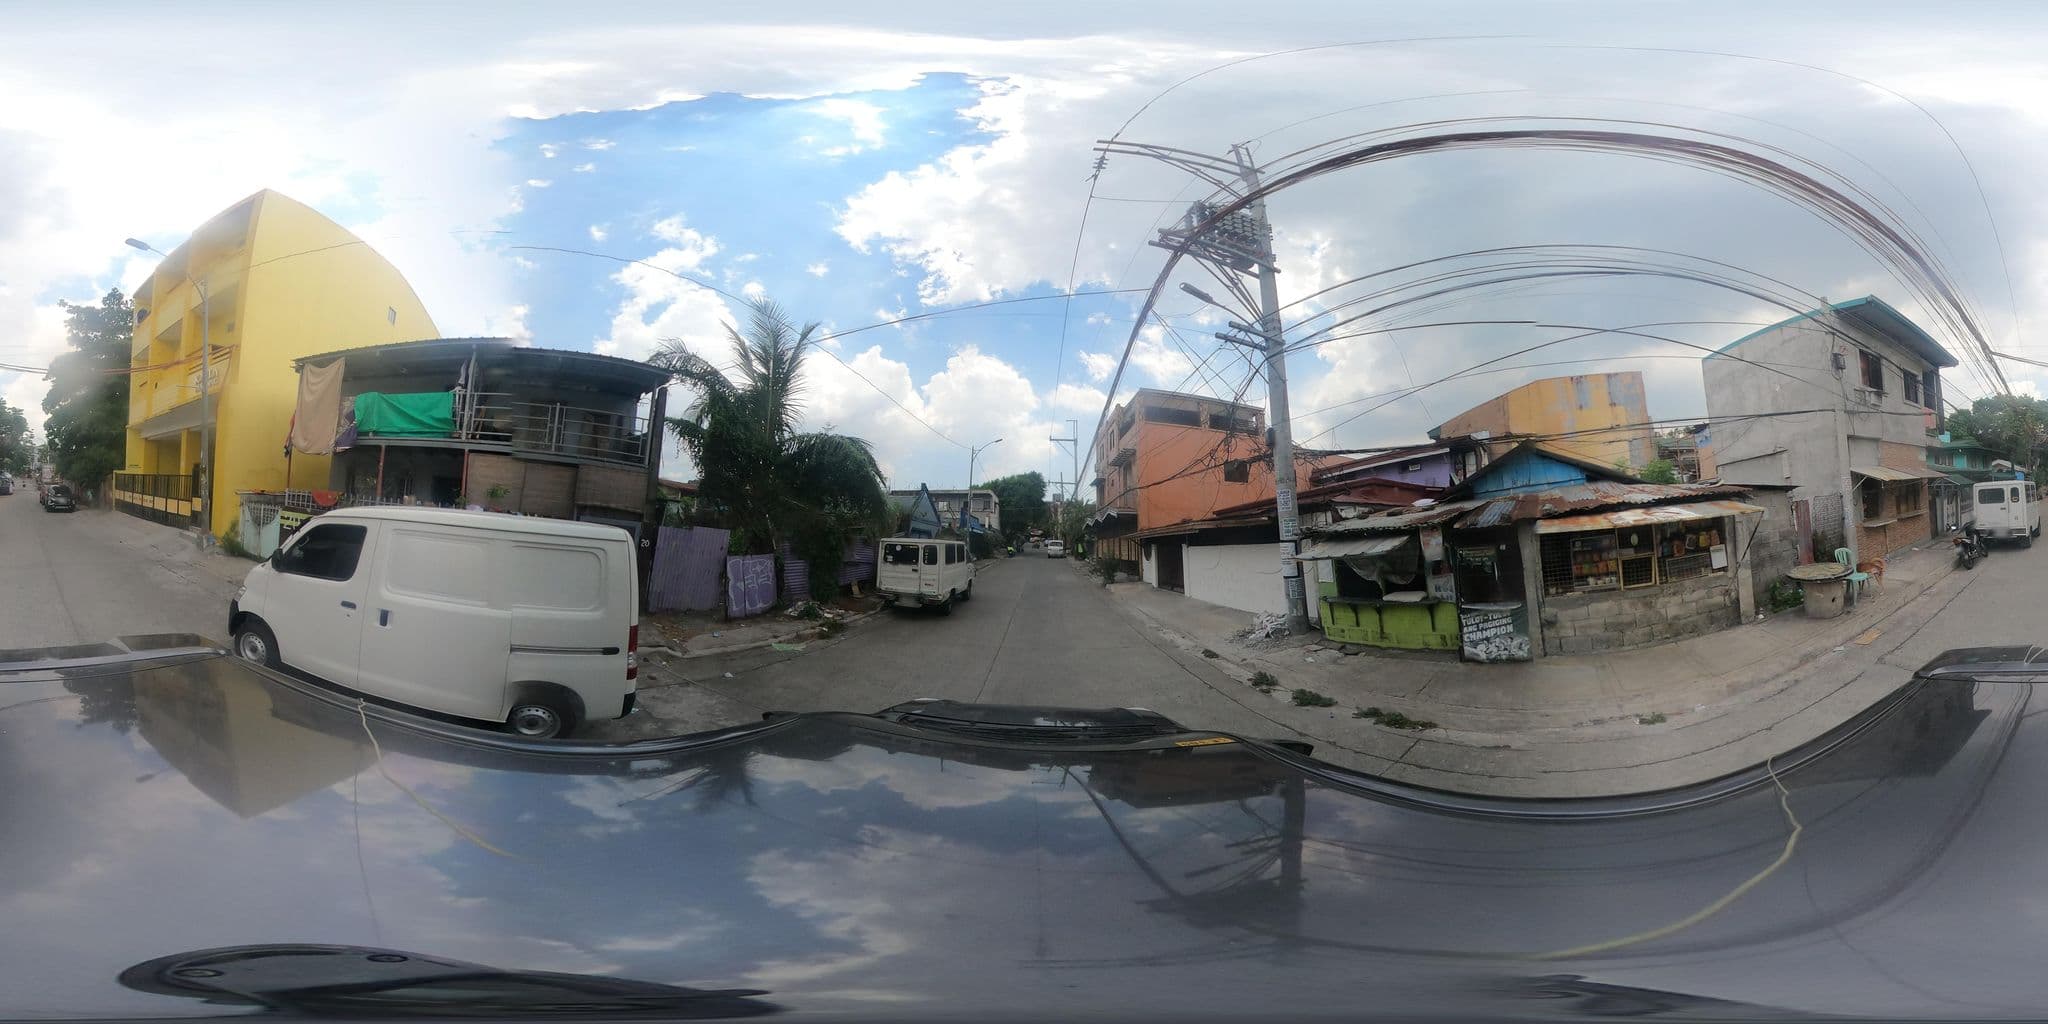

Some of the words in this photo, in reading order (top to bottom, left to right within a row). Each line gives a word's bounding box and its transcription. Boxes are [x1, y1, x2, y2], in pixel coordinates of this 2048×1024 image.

[640, 538, 650, 547] 20
[1463, 624, 1478, 632] ANG
[1478, 617, 1512, 630] PAGIGING
[1463, 624, 1514, 641] CHAMPION
